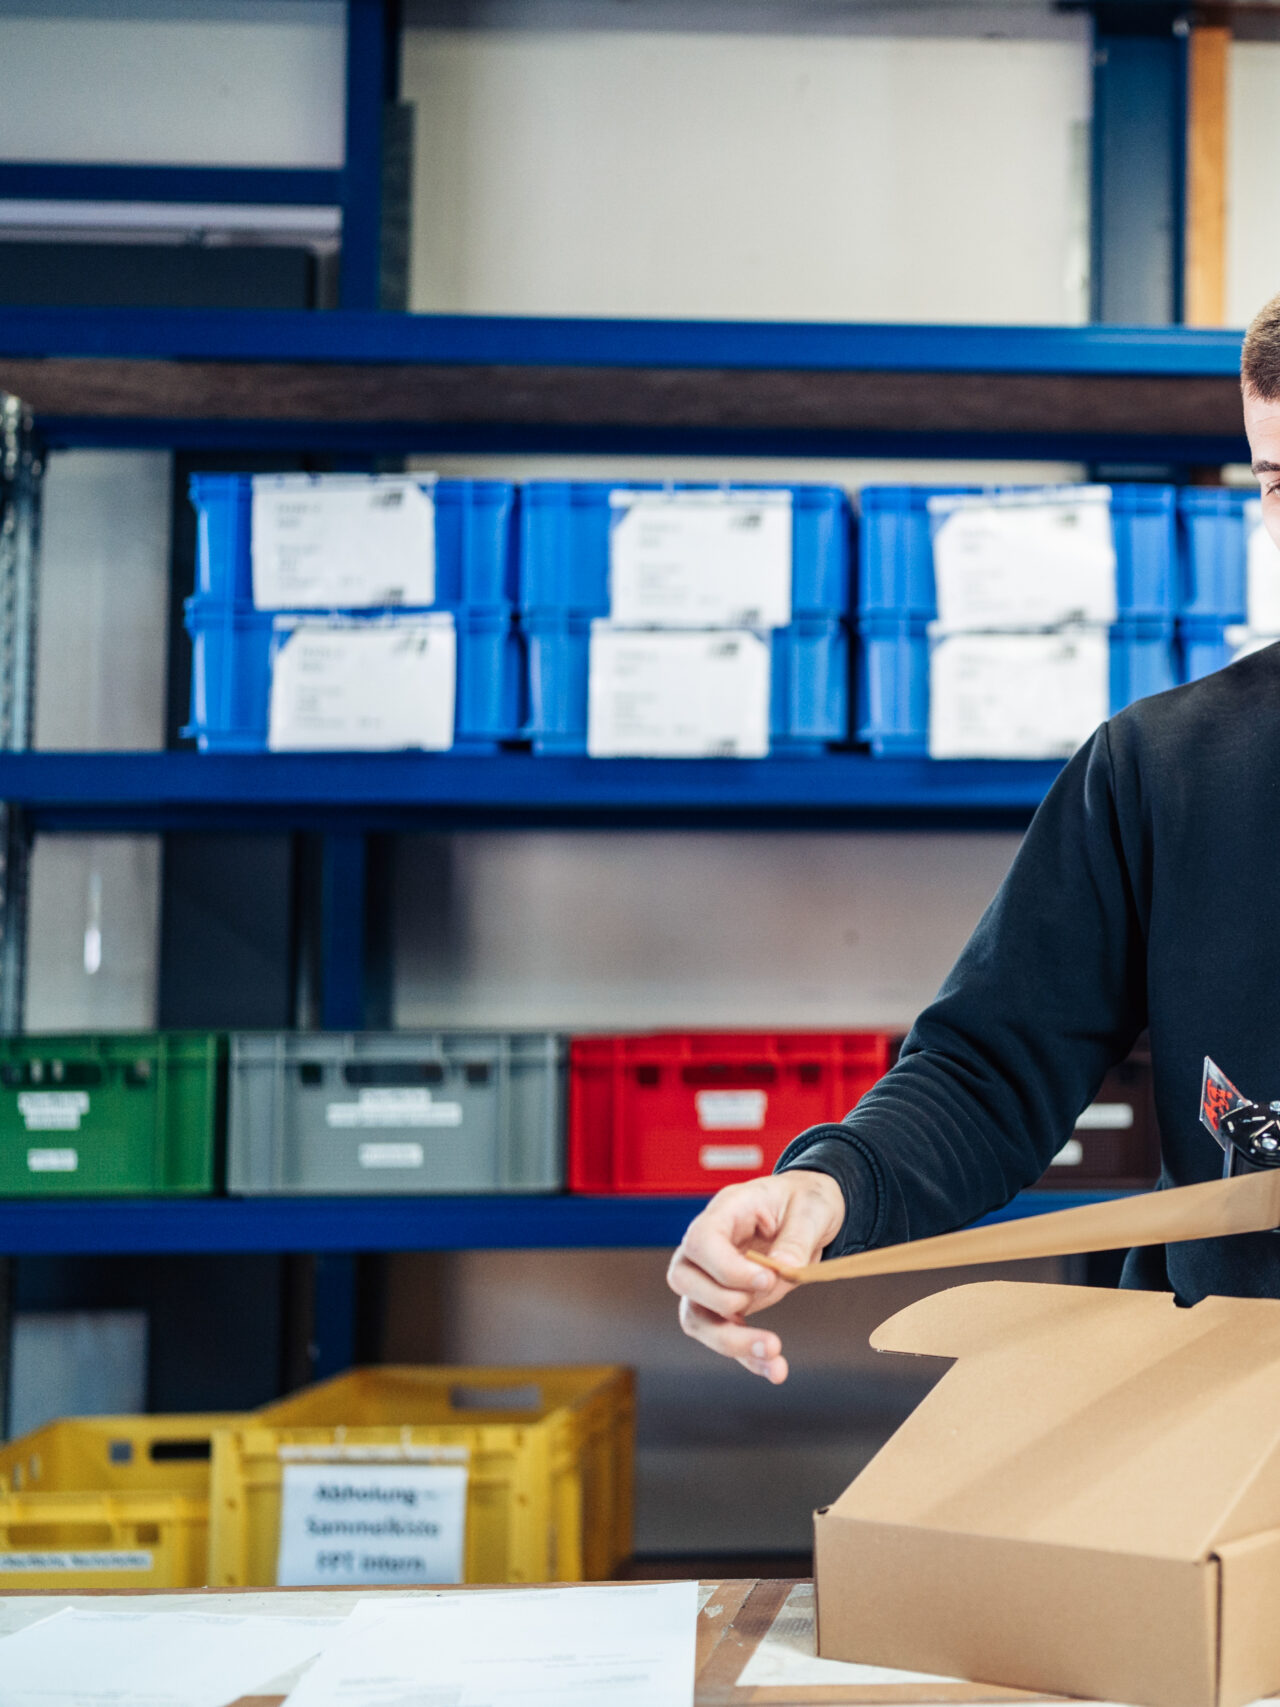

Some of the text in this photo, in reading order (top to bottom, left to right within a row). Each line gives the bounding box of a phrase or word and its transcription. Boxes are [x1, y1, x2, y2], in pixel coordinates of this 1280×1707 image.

[314, 1484, 418, 1507] Abholung
[304, 1516, 439, 1538] Sammelkiste
[316, 1550, 354, 1574] FPT
